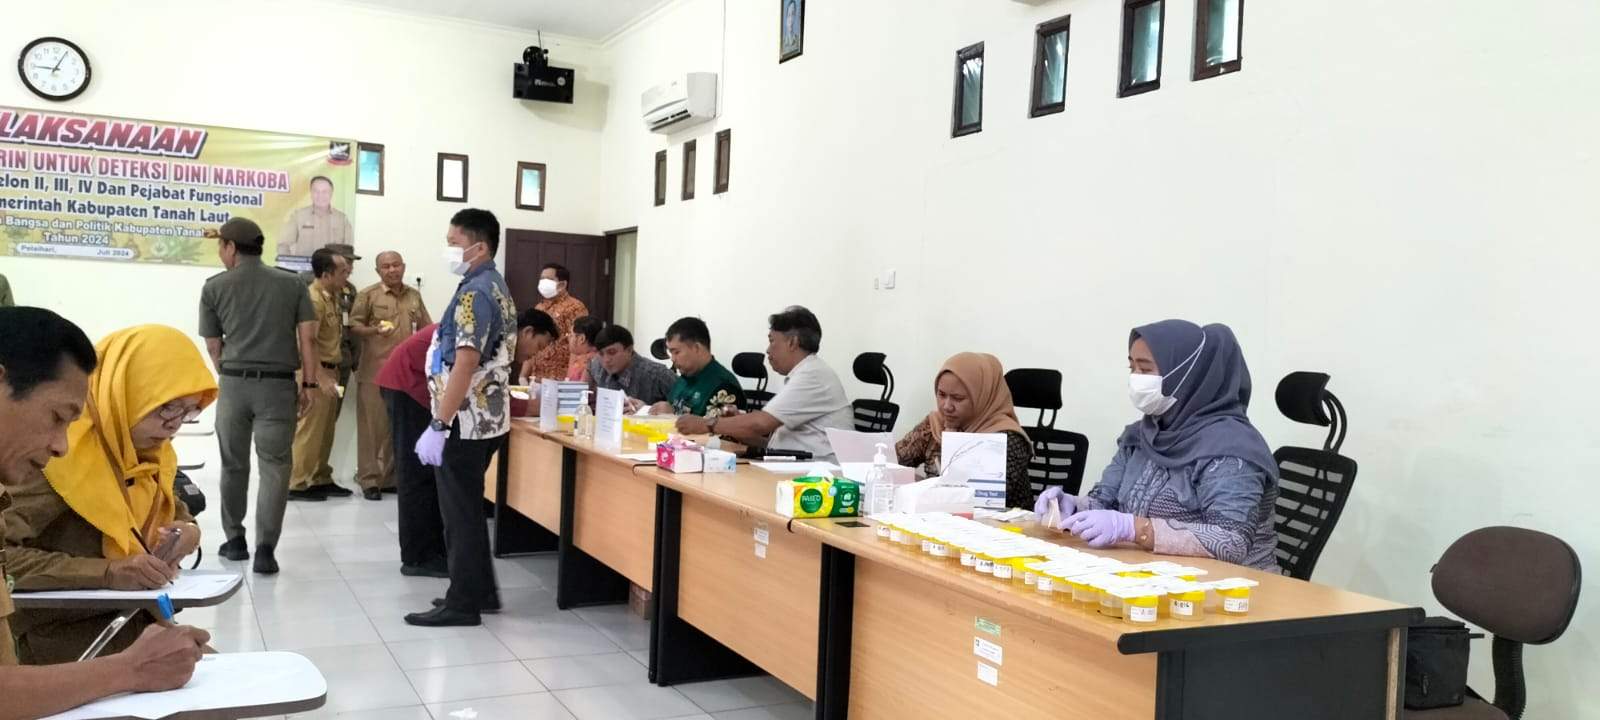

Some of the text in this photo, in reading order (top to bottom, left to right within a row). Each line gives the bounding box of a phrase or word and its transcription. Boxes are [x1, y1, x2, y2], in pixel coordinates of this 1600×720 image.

[0, 111, 203, 154] LAKSANAAN
[34, 152, 91, 174] UNTUK
[98, 157, 167, 180] DETEKSI
[173, 163, 207, 183] DINI
[213, 167, 287, 190] NARKOBA
[78, 179, 93, 193] IV
[97, 181, 126, 196] Dan
[131, 184, 185, 200] Pejabat
[189, 188, 262, 206] Fungsional
[67, 200, 147, 218] Kabupaten
[152, 205, 195, 221] Tanah
[200, 209, 229, 223] Laut
[5, 215, 49, 229] Bangsa
[52, 218, 73, 230] dan
[76, 221, 111, 232] Politik
[114, 222, 173, 235] Kabupaten
[43, 232, 109, 245] Tahun 2024
